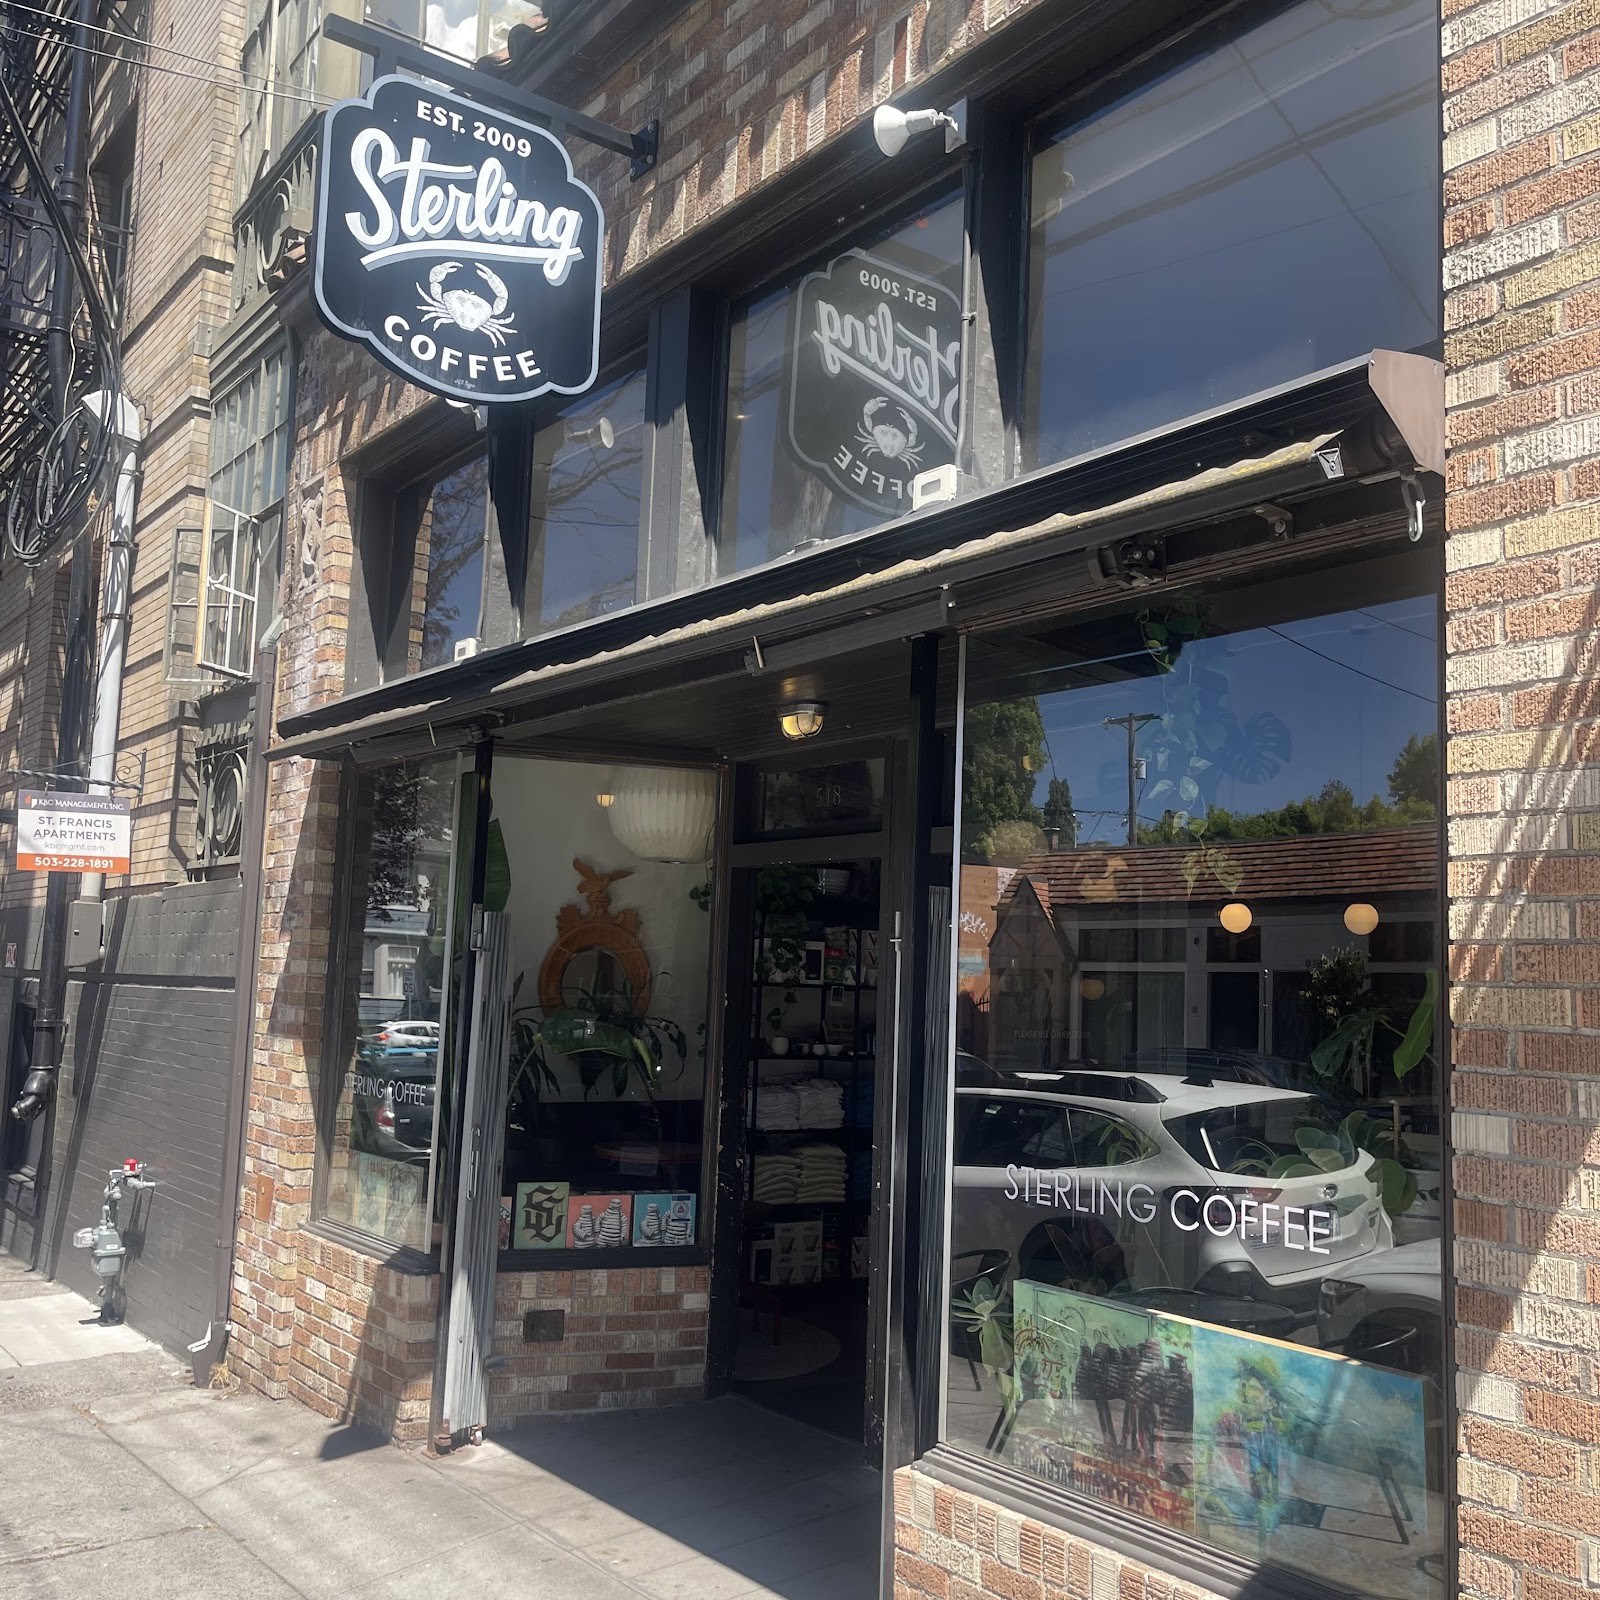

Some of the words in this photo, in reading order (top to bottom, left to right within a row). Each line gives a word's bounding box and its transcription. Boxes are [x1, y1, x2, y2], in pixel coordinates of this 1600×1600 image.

[416, 100, 466, 134] EST.
[474, 121, 532, 158] 2009
[345, 127, 584, 287] Sterling
[384, 315, 542, 382] COFFEE
[816, 785, 842, 808] 518
[33, 828, 116, 841] APARTMENTS
[38, 816, 55, 826] ST.
[59, 817, 112, 829] FRANCIS
[44, 841, 105, 852] kbcmgmt.com
[34, 856, 114, 869] 503-228-1891
[344, 1072, 386, 1099] STERLING
[387, 1079, 427, 1107] COFFEE
[1004, 1163, 1157, 1224] STERLING
[1170, 1189, 1331, 1255] COFFEE
